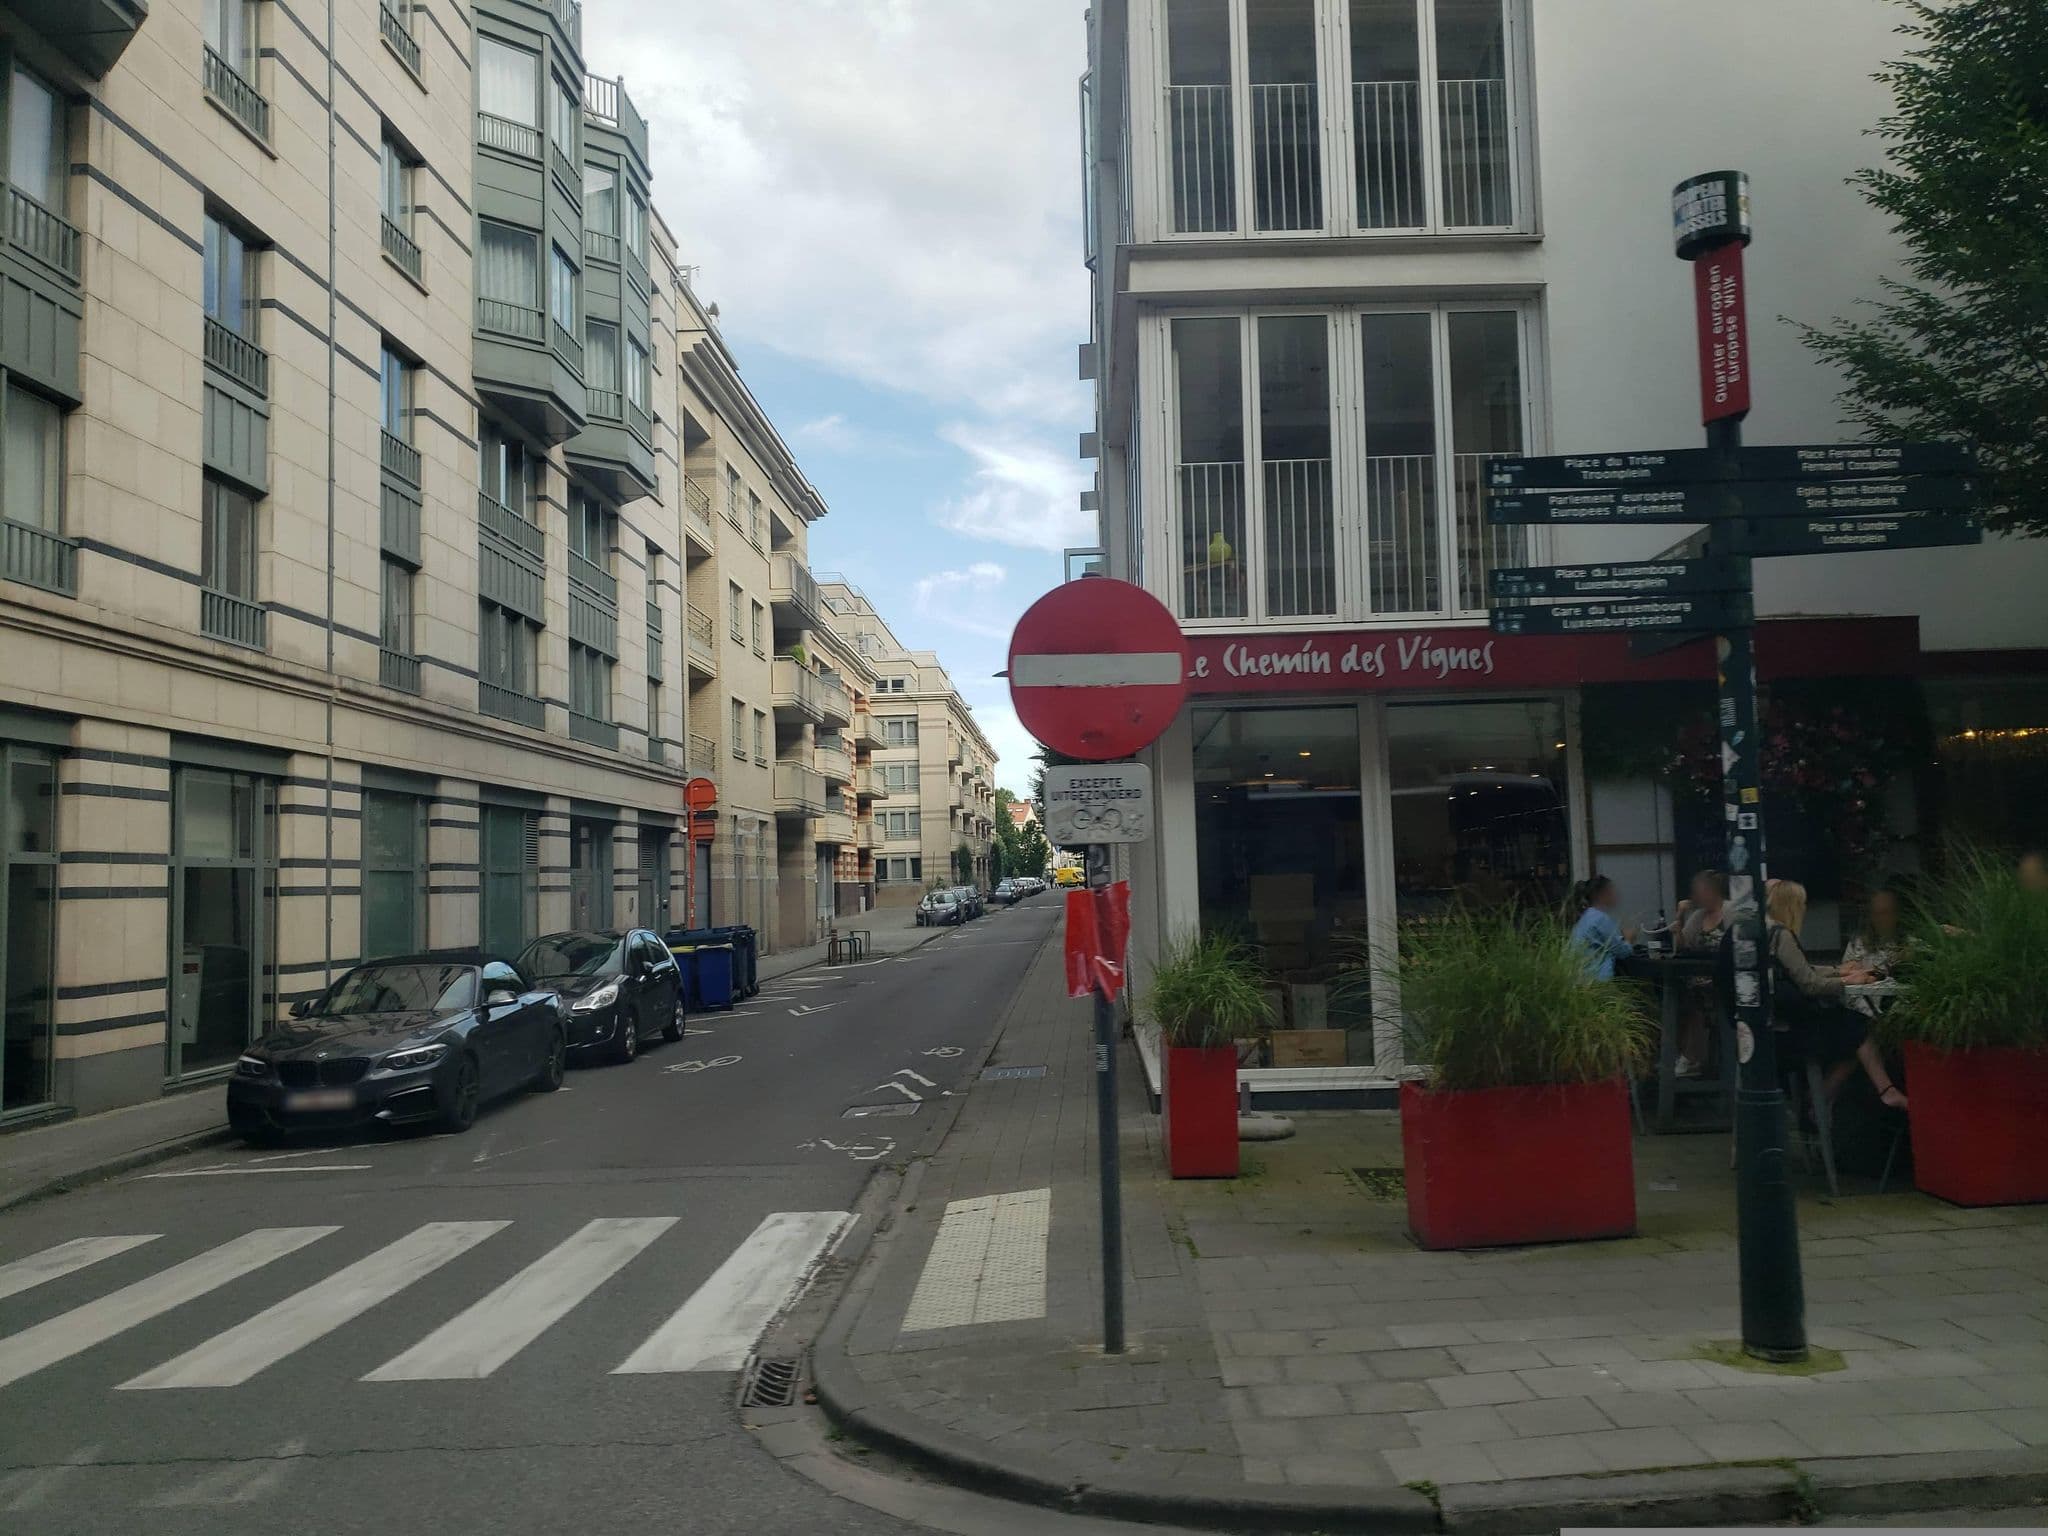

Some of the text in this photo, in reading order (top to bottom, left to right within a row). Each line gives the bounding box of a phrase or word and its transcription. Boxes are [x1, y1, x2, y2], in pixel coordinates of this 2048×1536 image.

[1723, 275, 1741, 383] Europese Wijk
[1713, 343, 1728, 403] Quartier
[1797, 450, 1826, 460] Place
[1564, 458, 1600, 468] Place
[1605, 457, 1622, 466] du
[1581, 468, 1651, 480] Troonplein
[1548, 494, 1615, 506] Parlement
[1550, 504, 1684, 518] Europees Parlement
[1808, 522, 1900, 532] Place de Londres
[1555, 566, 1686, 579] Place du Luxembourg
[1574, 578, 1668, 590] Luxemburgplein
[1551, 602, 1692, 617] Gare du Luxembourg
[1562, 614, 1682, 629] Luxemburgstation
[1341, 642, 1387, 678] des
[1397, 635, 1495, 680] Vignes
